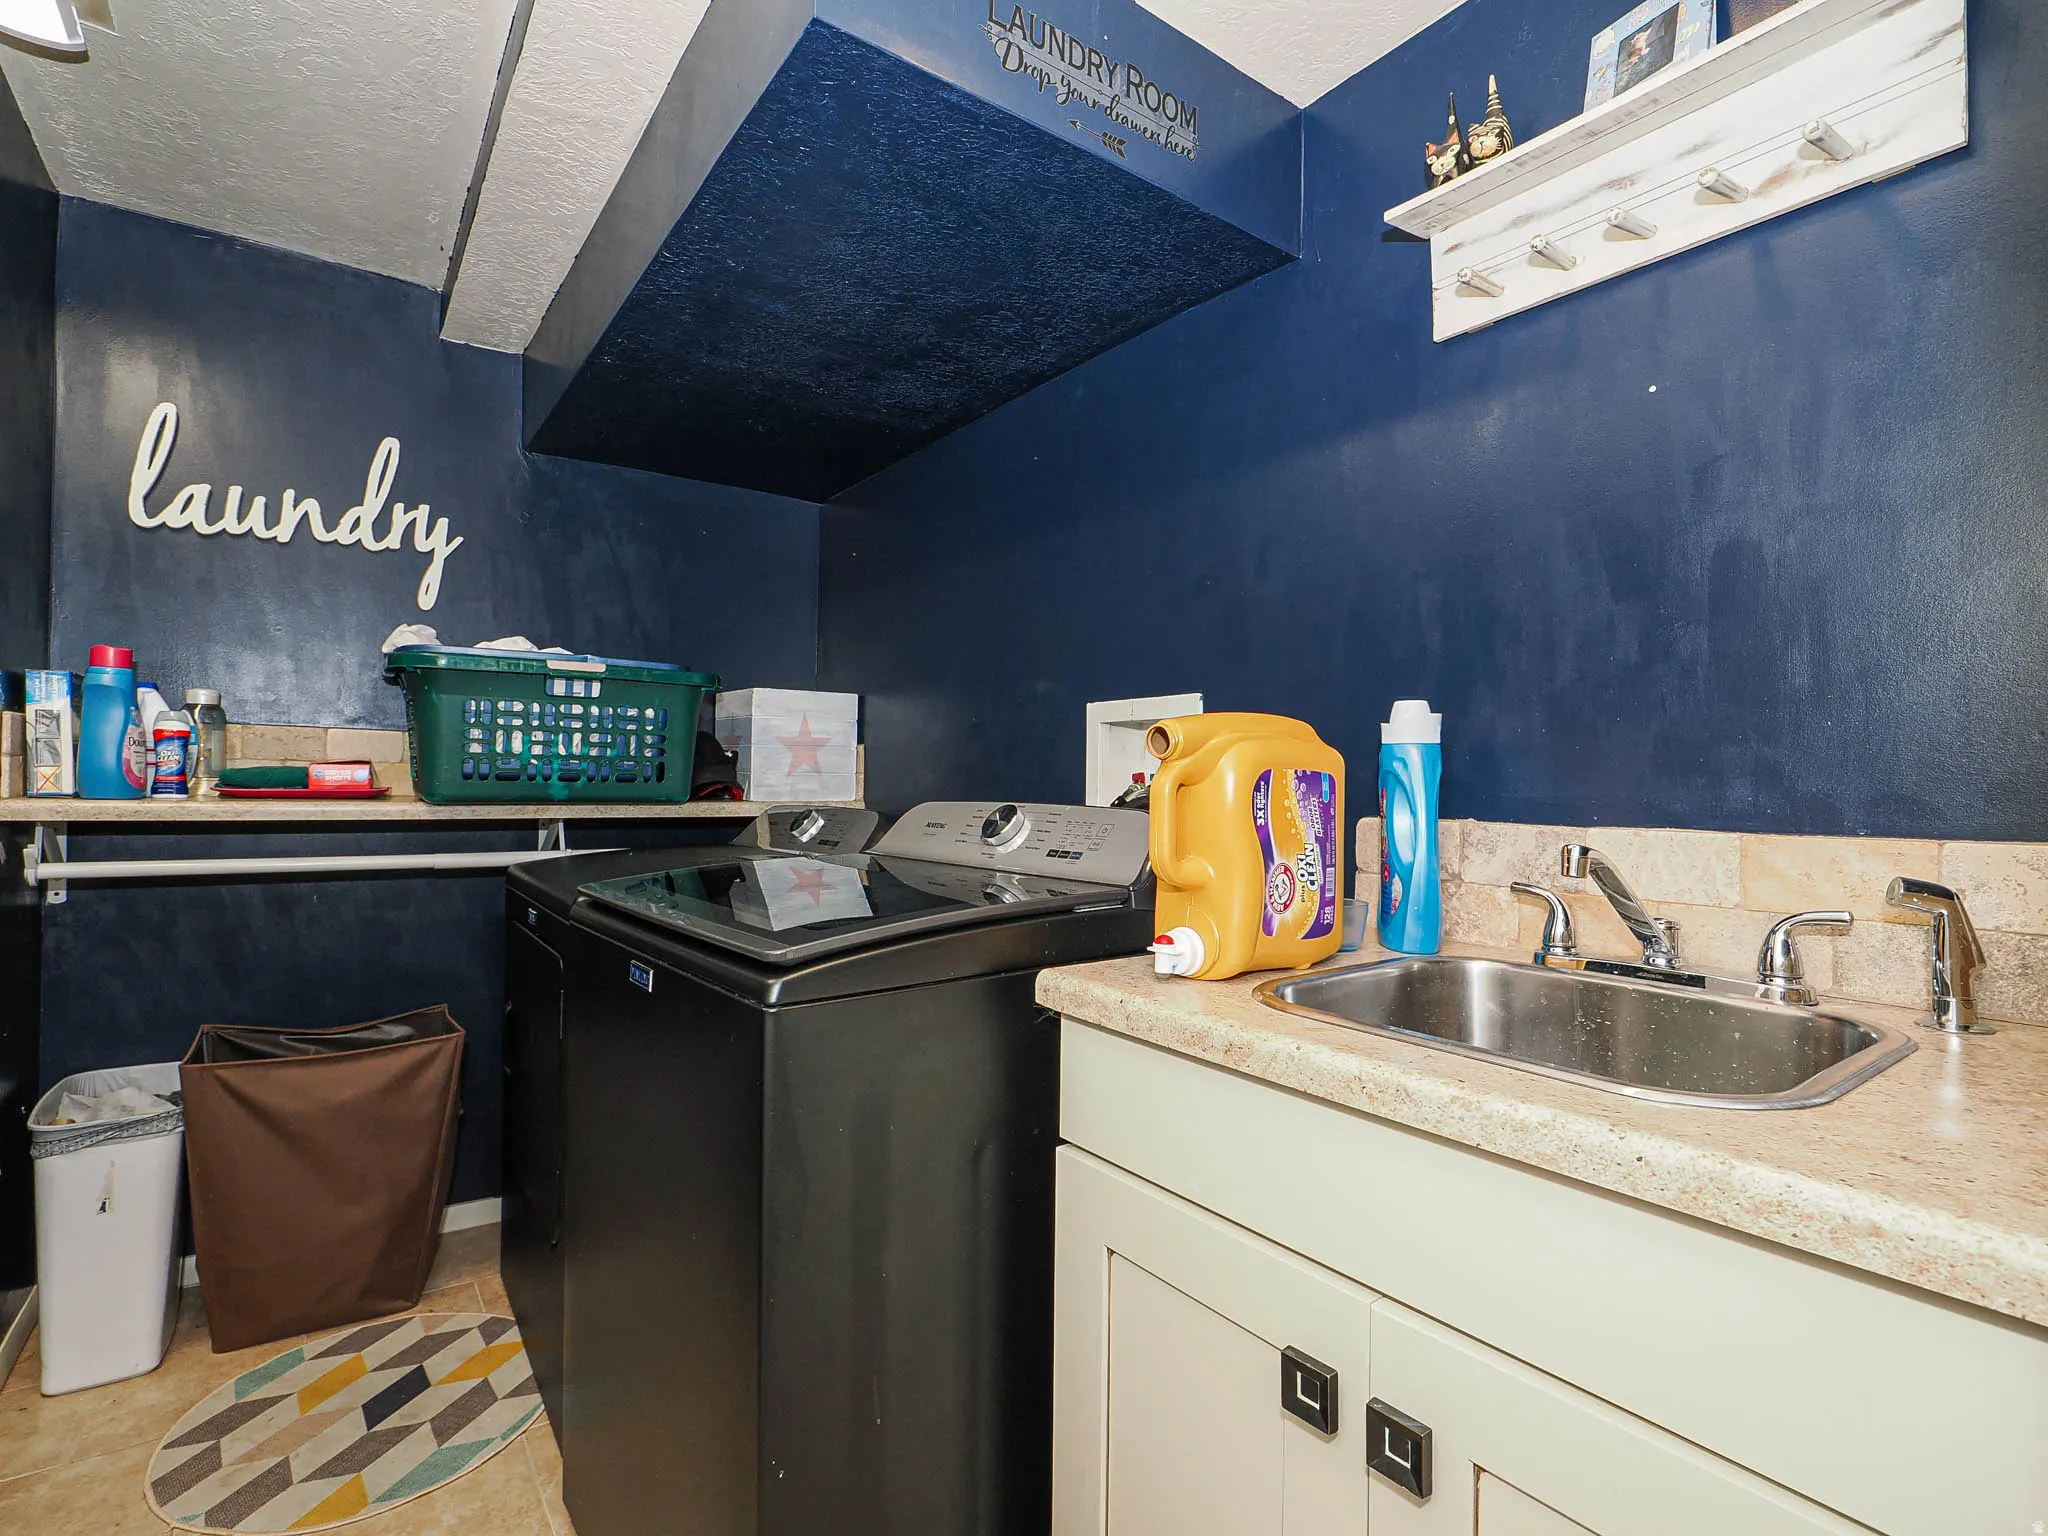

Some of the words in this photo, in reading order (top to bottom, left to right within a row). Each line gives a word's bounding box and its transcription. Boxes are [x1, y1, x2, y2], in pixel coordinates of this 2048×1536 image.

[988, 0, 1119, 90] LAUNDRY
[1126, 62, 1198, 136] ROOM
[994, 36, 1057, 93] Drop
[1055, 74, 1101, 106] your
[1104, 94, 1162, 145] drawers
[1164, 125, 1197, 163] here
[128, 402, 464, 611] laundry
[925, 821, 948, 829] MAYTAG
[1256, 808, 1265, 827] 3X
[1308, 807, 1316, 830] ODOR
[1312, 798, 1322, 836] BLASTERS
[1296, 853, 1309, 883] OXI
[1304, 842, 1319, 892] CLEAN
